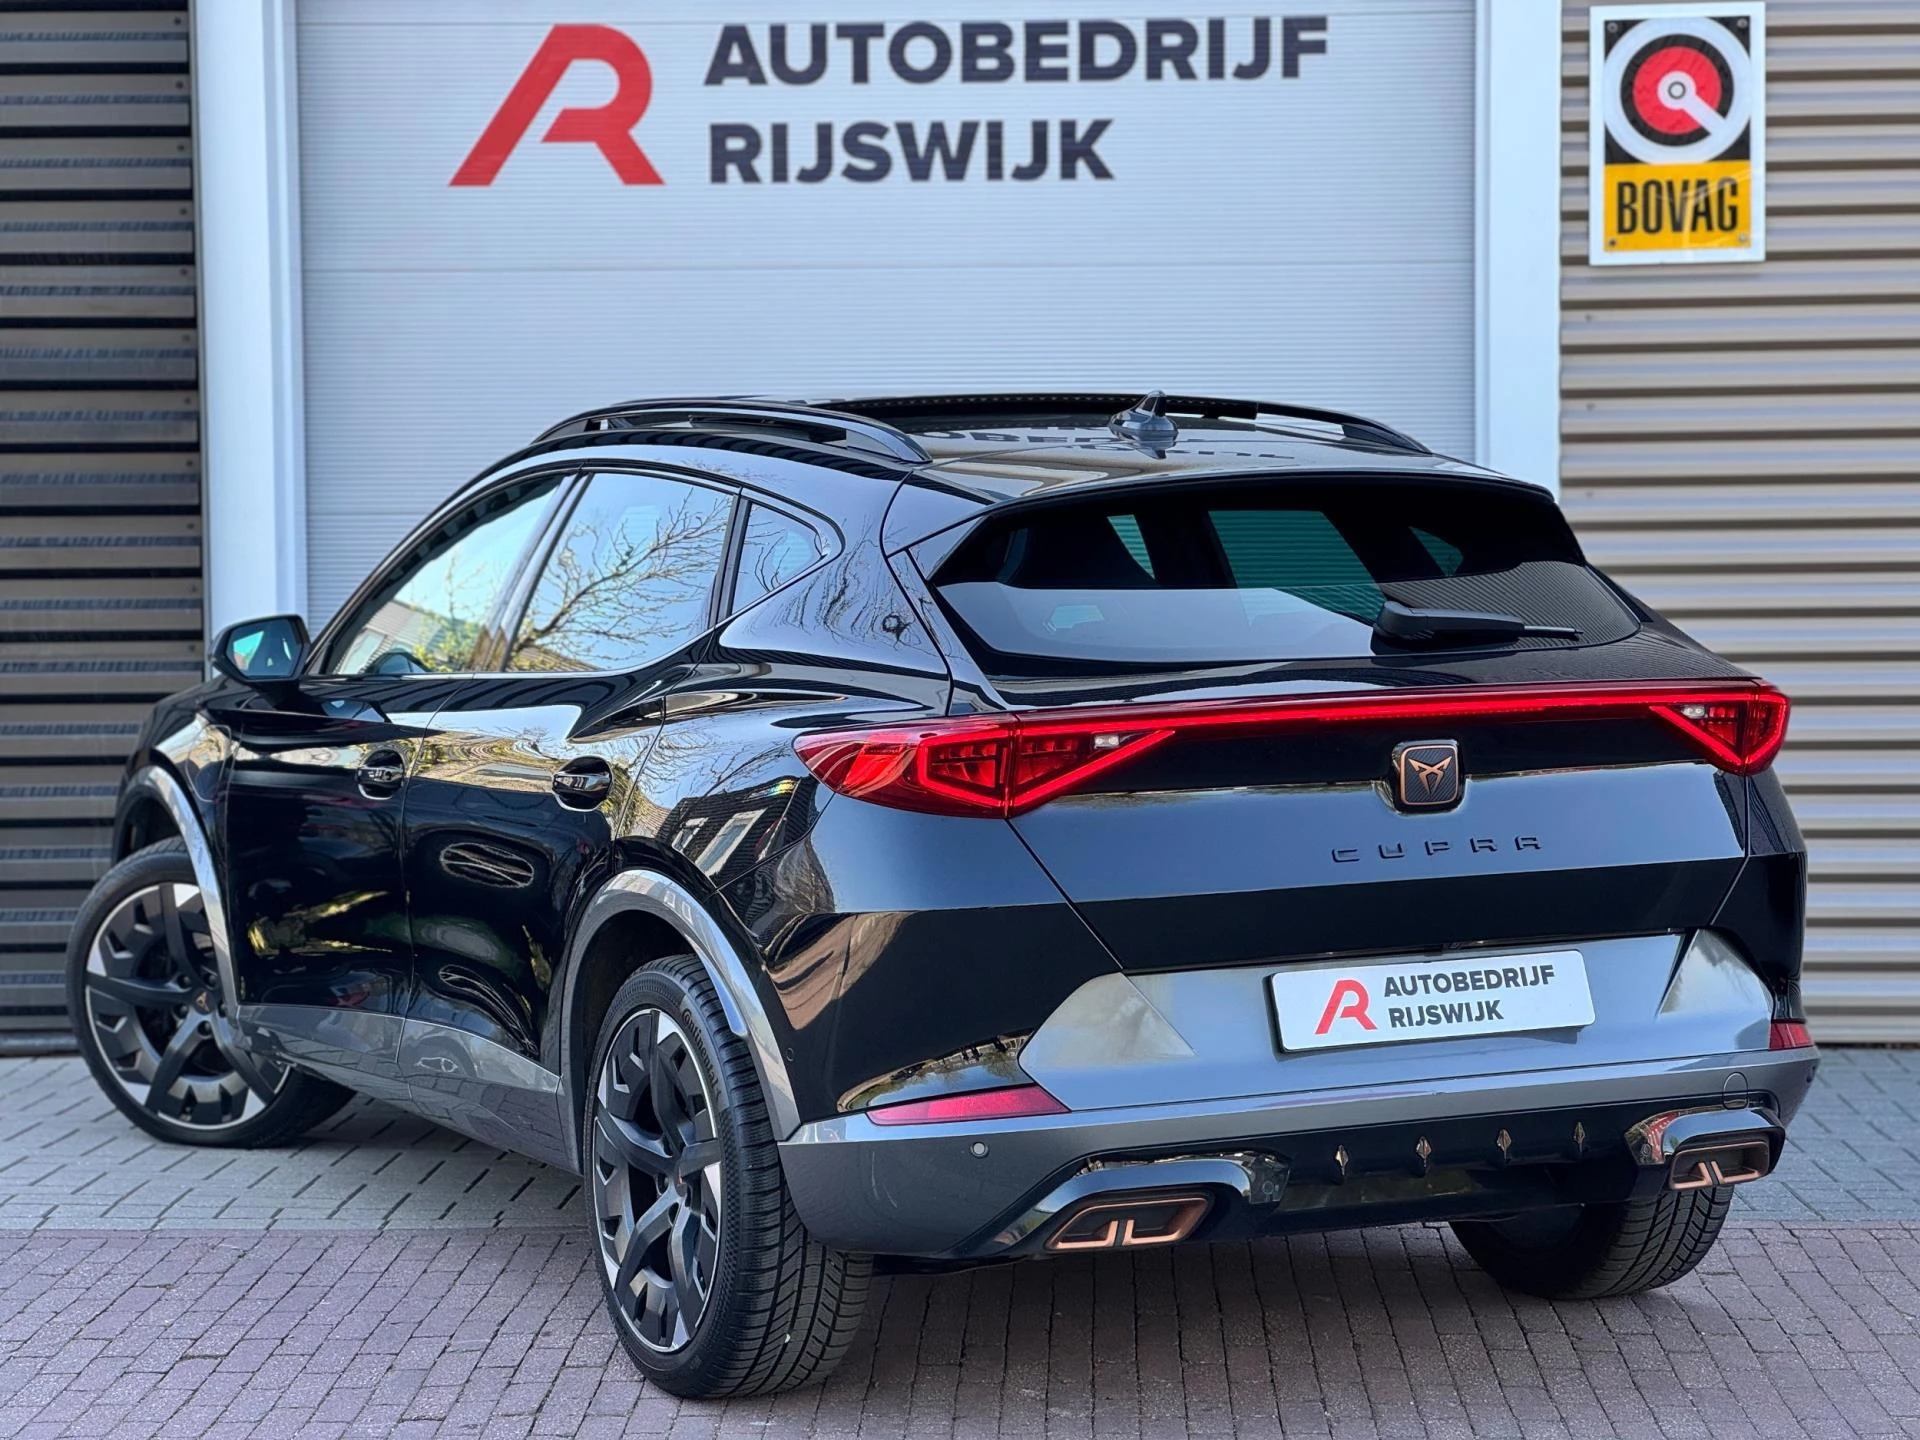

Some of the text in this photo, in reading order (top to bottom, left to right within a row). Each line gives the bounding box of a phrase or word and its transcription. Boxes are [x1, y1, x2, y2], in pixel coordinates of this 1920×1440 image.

[703, 16, 1328, 86] AUTOBEDRIJF
[710, 119, 1116, 184] RIJSWIJK
[1617, 177, 1738, 234] BOVAG
[1331, 835, 1543, 863] CUPRA
[1384, 964, 1555, 998] AUTOBEDRIJF
[1388, 1000, 1504, 1029] RIJSWIJK
